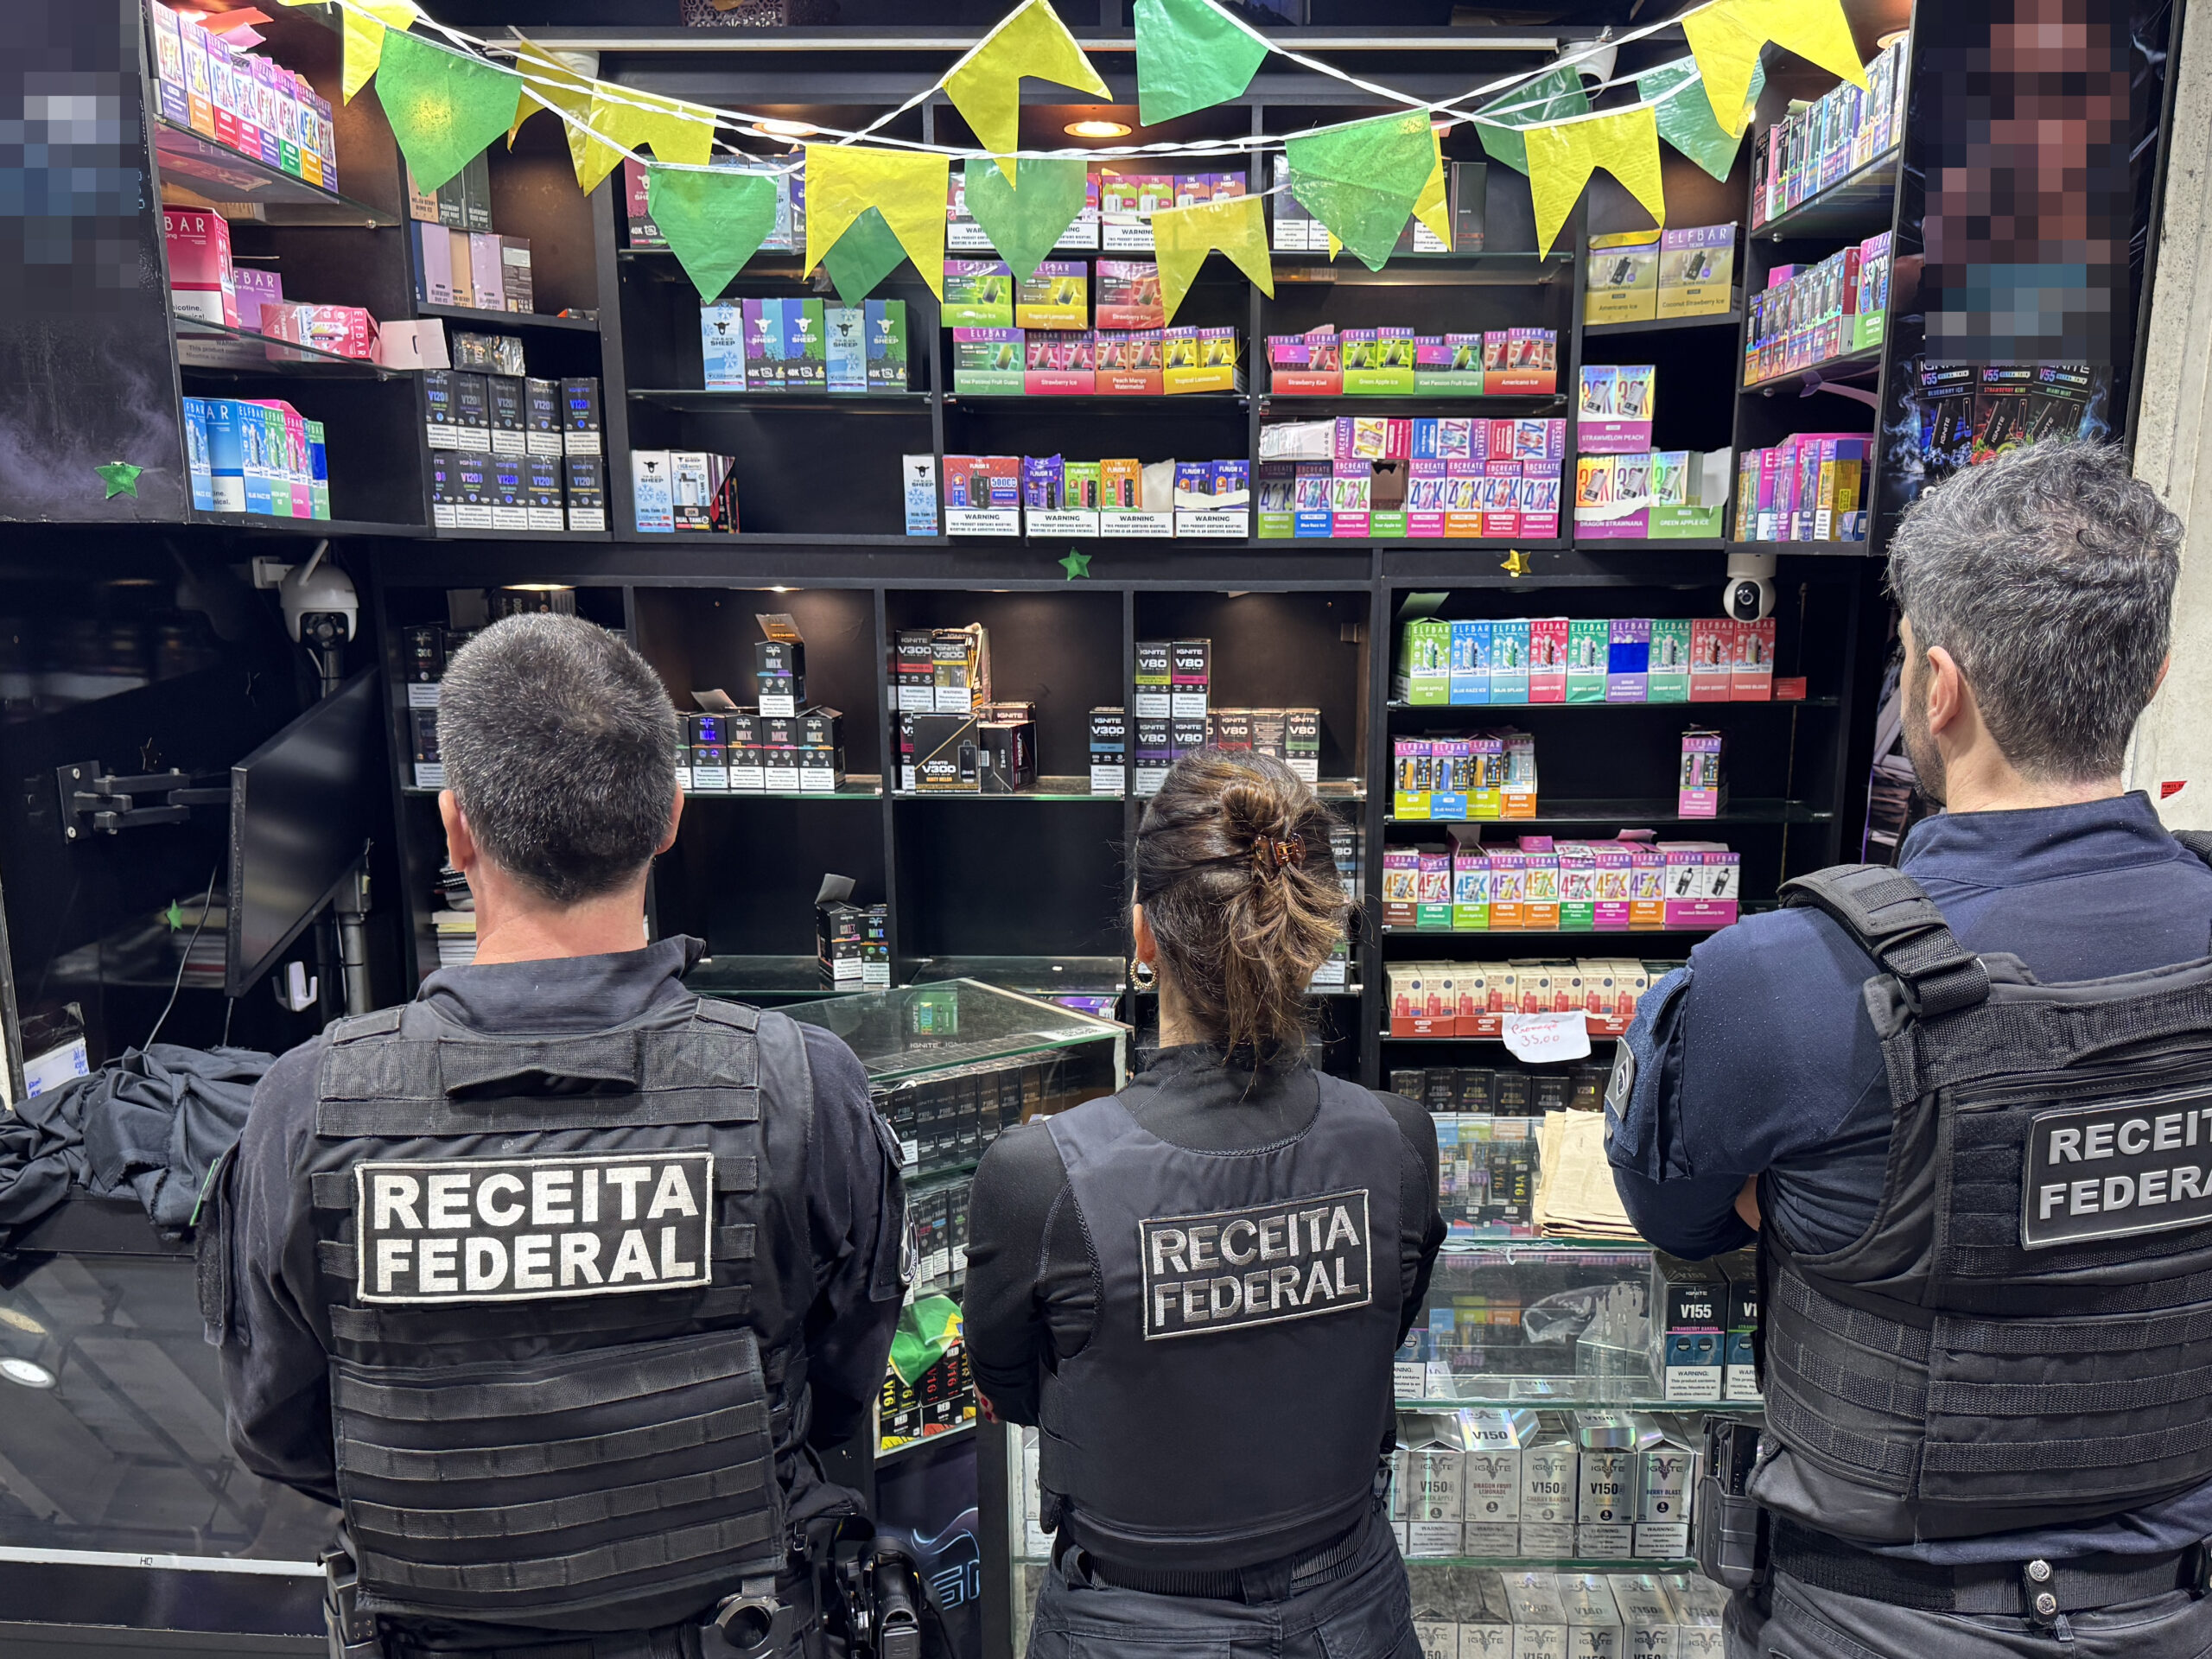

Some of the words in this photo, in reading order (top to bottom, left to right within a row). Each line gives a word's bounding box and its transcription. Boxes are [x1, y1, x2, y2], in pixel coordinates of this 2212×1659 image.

[164, 216, 206, 232] BAR
[631, 226, 643, 236] 40K
[1668, 227, 1728, 244] ELFBAR
[232, 270, 275, 289] FBAR
[1686, 299, 1715, 308] Strawberry
[353, 309, 366, 357] ELFBAR
[970, 328, 1007, 339] ELFBAR
[1380, 327, 1411, 336] ELFBAR
[1511, 328, 1542, 337] ELFBAR
[747, 368, 760, 378] 40K
[787, 367, 799, 378] 40K
[868, 369, 880, 379] 40K
[1982, 369, 1999, 382] V55
[2038, 367, 2056, 382] V55
[1040, 378, 1067, 387] Strawberry
[1128, 377, 1147, 385] Mango
[1287, 378, 1313, 388] Strawberry
[1374, 378, 1389, 387] Apple
[1921, 372, 1938, 386] V55
[1927, 387, 1955, 397] BLUEBERRY
[186, 402, 205, 415] FBAR
[238, 405, 264, 419] ELFBAR
[264, 410, 284, 423] LFBAR
[285, 417, 302, 429] LFBAR
[1939, 416, 1951, 445] IGNITE
[1992, 416, 2005, 443] IGNITE
[1620, 434, 1644, 442] PEACH
[1335, 461, 1370, 472] EBCREATE
[1411, 461, 1446, 471] EBCREATE
[1449, 461, 1483, 471] EBCREATE
[1524, 461, 1560, 472] EBCREATE
[1413, 626, 1450, 634] ELFBAR
[1492, 624, 1529, 632] ELFBAR
[1530, 622, 1567, 631] ELFBAR
[1571, 623, 1608, 632] ELFBAR
[1612, 622, 1649, 631] ELFBAR
[1652, 622, 1690, 631] ELFBAR
[1696, 621, 1733, 630] ELFBAR
[766, 658, 782, 669] MIX
[1138, 659, 1167, 668] V80
[1175, 658, 1205, 668] V80
[699, 730, 715, 741] MIX
[735, 730, 753, 741] MIX
[1091, 726, 1125, 735] V300
[1220, 726, 1249, 735] V80
[1289, 726, 1316, 735] V80
[772, 731, 788, 742] MIX
[806, 731, 823, 742] MIX
[1138, 734, 1166, 743] V80
[1174, 734, 1203, 743] V80
[921, 765, 957, 773] V300
[1632, 854, 1665, 862] ELFBAR
[1669, 854, 1701, 862] ELFBAR
[1706, 855, 1738, 863] ELFBAR
[868, 928, 884, 938] MIX
[2048, 1108, 2212, 1166] RECEI
[373, 1164, 699, 1230] RECEITA
[2039, 1166, 2212, 1220] FEDER
[1151, 1205, 1361, 1275] RECEITA
[376, 1226, 696, 1293] FEDERAL
[1154, 1256, 1361, 1327] FEDERAL
[1679, 1304, 1713, 1319] V155
[883, 1379, 895, 1408] V16
[1472, 1430, 1508, 1440] V150
[1420, 1481, 1448, 1494] V150
[1531, 1481, 1560, 1495] V150
[1590, 1482, 1619, 1496] V150
